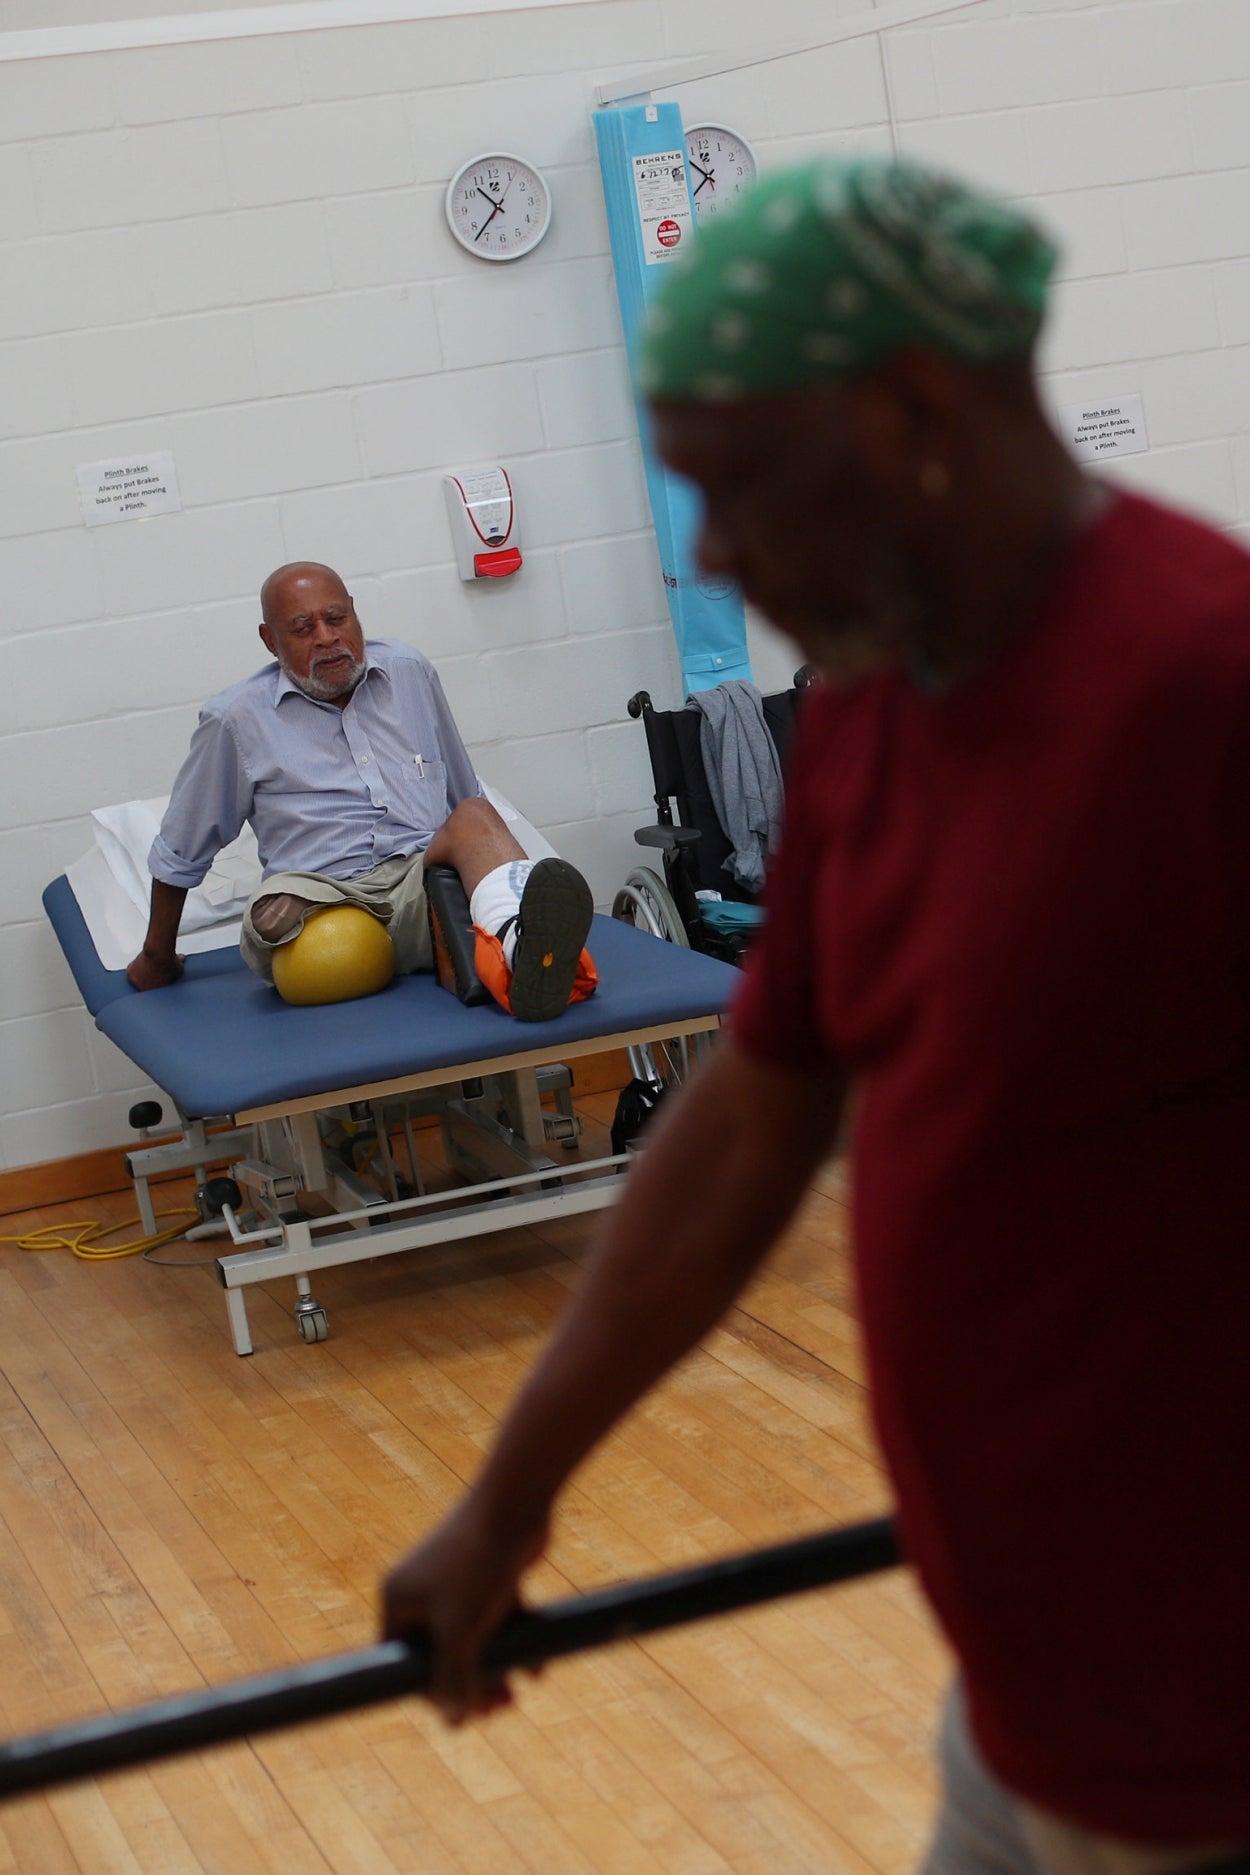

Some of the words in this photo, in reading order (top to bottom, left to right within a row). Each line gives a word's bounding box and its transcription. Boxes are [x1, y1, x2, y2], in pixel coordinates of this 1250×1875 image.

[698, 139, 709, 150] 12
[717, 142, 721, 151] 1
[636, 153, 681, 165] BEHRENS
[728, 152, 735, 161] 2
[488, 169, 499, 179] 12
[507, 171, 512, 181] 1
[737, 166, 743, 176] 3
[474, 176, 484, 186] 11
[519, 182, 526, 191] 2
[464, 189, 476, 199] 10
[528, 197, 534, 206] 3
[461, 206, 468, 215] 9
[524, 214, 530, 223] 4
[471, 222, 478, 230] 8
[484, 232, 490, 242] 7
[515, 228, 521, 237] 5
[499, 234, 506, 243] 6
[1082, 410, 1100, 419] Plinth
[1101, 408, 1120, 416] Brakes
[1077, 424, 1098, 432] Always
[1099, 421, 1109, 429] put
[1110, 418, 1130, 426] Brakes
[1114, 428, 1135, 436] moving
[1100, 441, 1118, 449] Plinth.
[104, 469, 124, 478] Plinth
[126, 465, 148, 474] Brakes
[99, 483, 122, 492] Always
[124, 481, 135, 489] put
[137, 476, 159, 485] Brakes
[96, 496, 111, 504] back
[124, 491, 140, 499] after
[141, 487, 166, 496] moving
[125, 501, 147, 511] Plinth.
